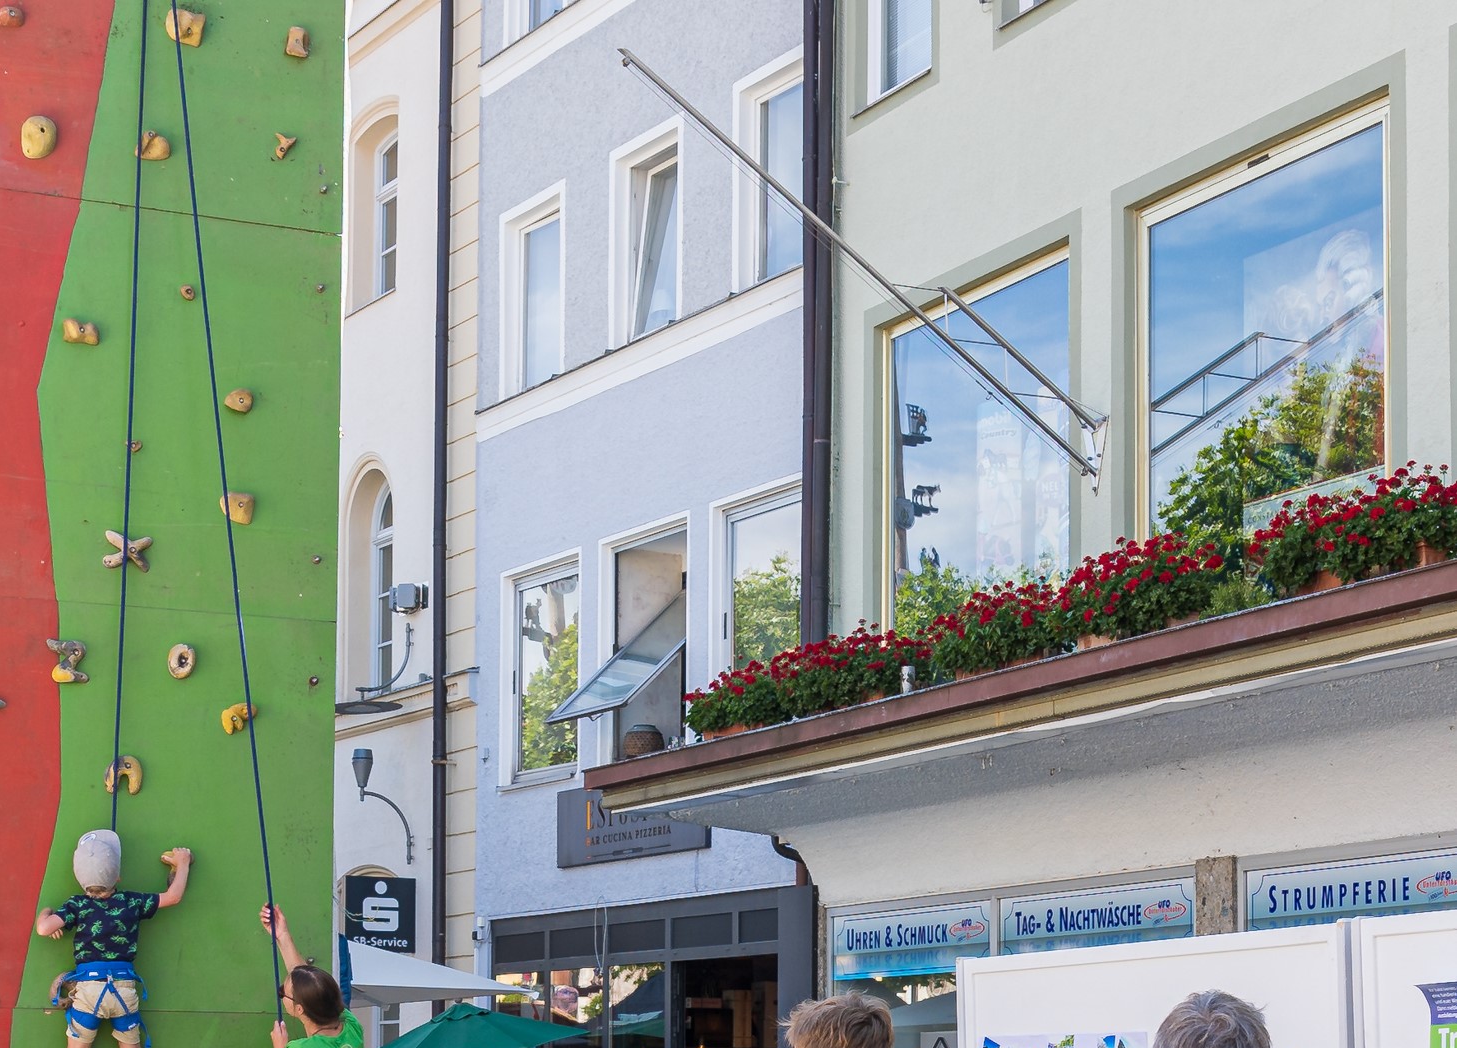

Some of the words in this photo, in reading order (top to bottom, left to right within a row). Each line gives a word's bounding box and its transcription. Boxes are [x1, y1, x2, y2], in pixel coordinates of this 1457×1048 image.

[603, 832, 633, 844] CUCINA
[635, 825, 672, 840] PIZZERIA
[1435, 870, 1452, 881] UFO
[1269, 876, 1410, 914] STRUMPFERIE
[1015, 911, 1041, 936] TAG-
[1045, 908, 1055, 933] &
[1059, 901, 1142, 932] NACHTWÄSCHE
[353, 936, 408, 947] SB-Service
[846, 929, 881, 950] UHREN
[884, 925, 893, 948] &
[897, 923, 948, 947] SCHMUCK
